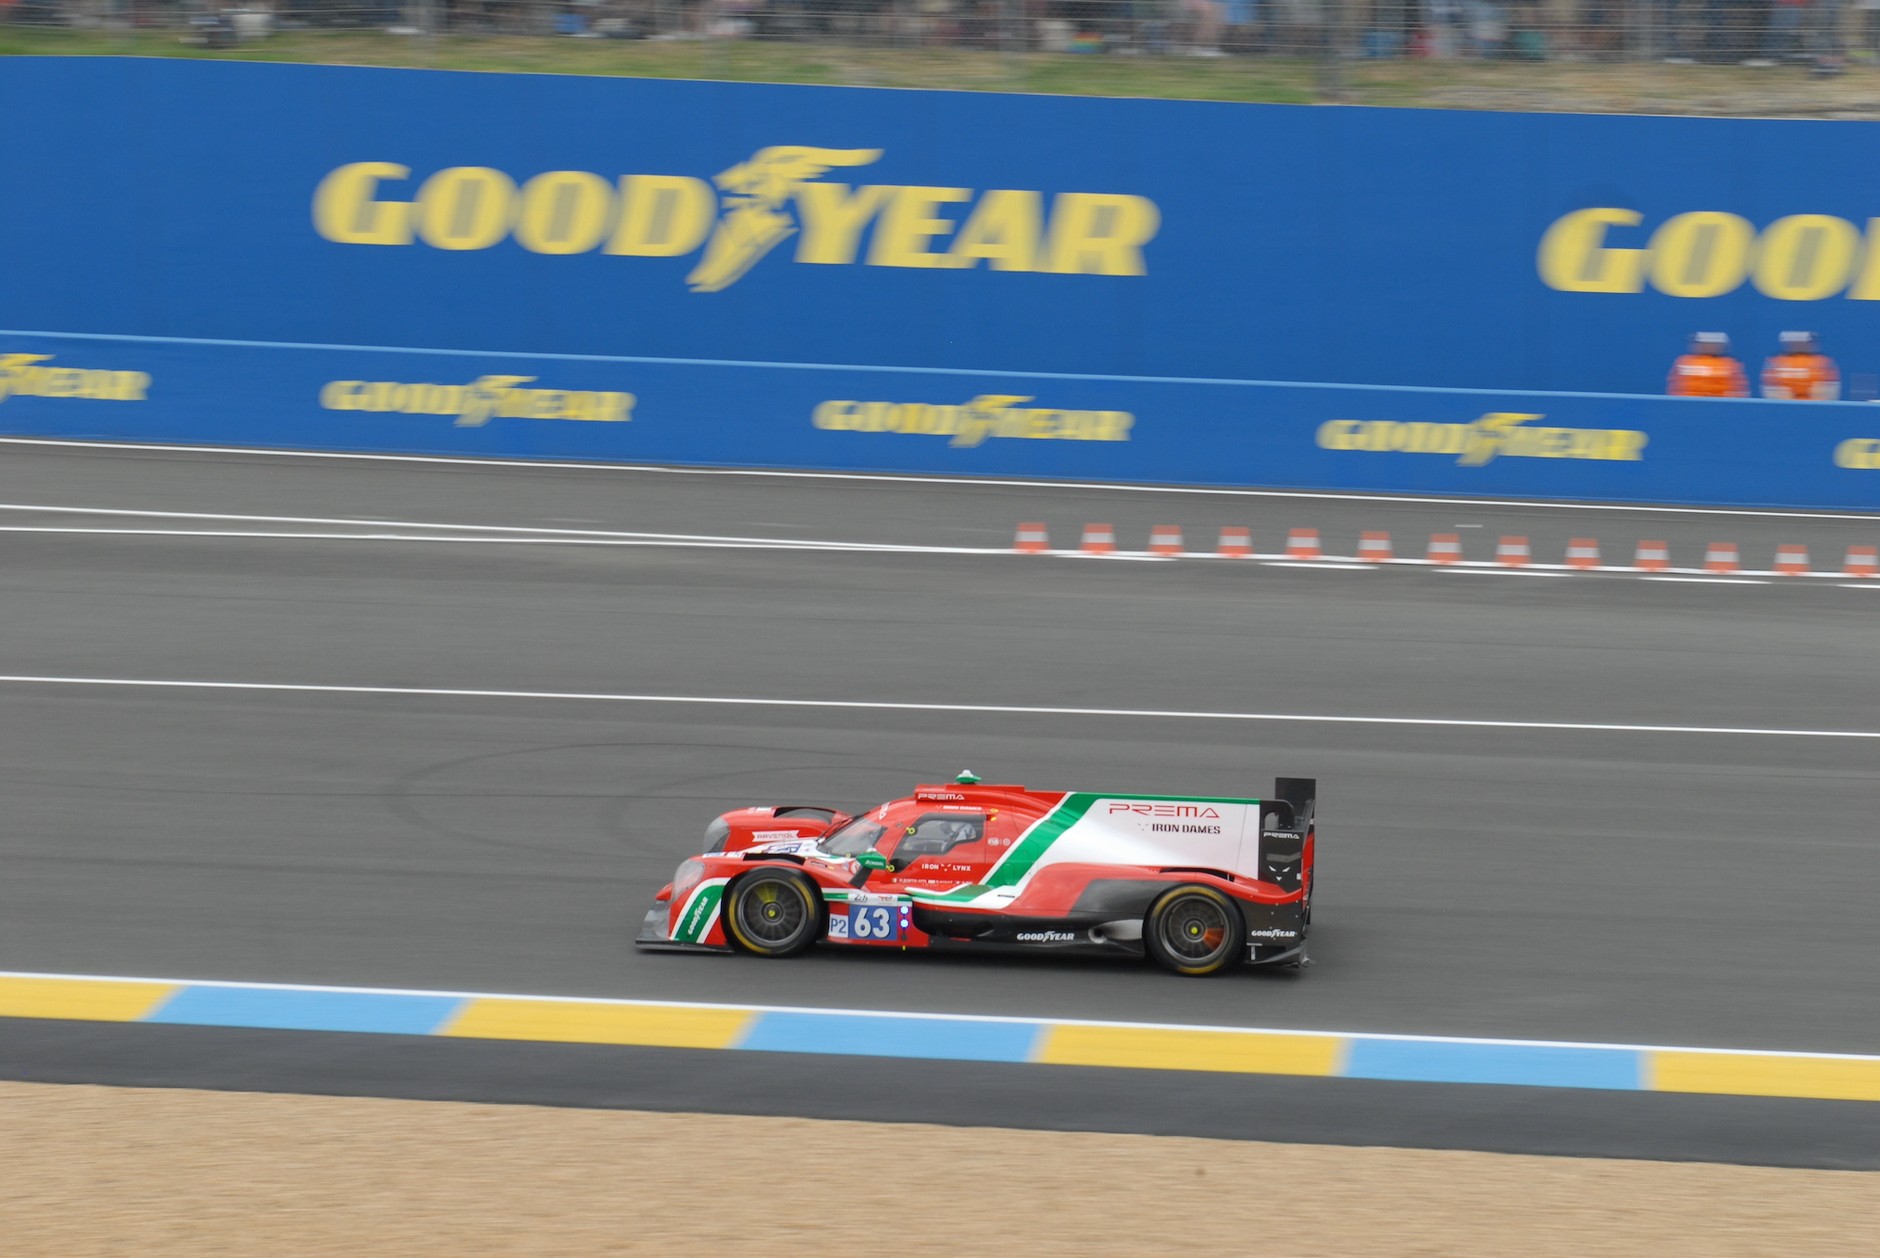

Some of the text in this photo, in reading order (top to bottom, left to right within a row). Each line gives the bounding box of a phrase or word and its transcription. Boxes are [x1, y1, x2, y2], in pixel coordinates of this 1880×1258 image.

[313, 152, 1161, 286] GOODYEAR
[321, 376, 636, 424] GOODYEAR
[813, 396, 1134, 444] GOODYEAR
[1317, 414, 1648, 463] GOODYEAR
[1109, 803, 1220, 818] PREMA
[1152, 823, 1221, 834] IRON DAMES
[831, 918, 846, 934] P2
[855, 908, 890, 938] 63
[1250, 929, 1295, 938] GOODYEAR
[1017, 930, 1075, 942] GOODYEAR
